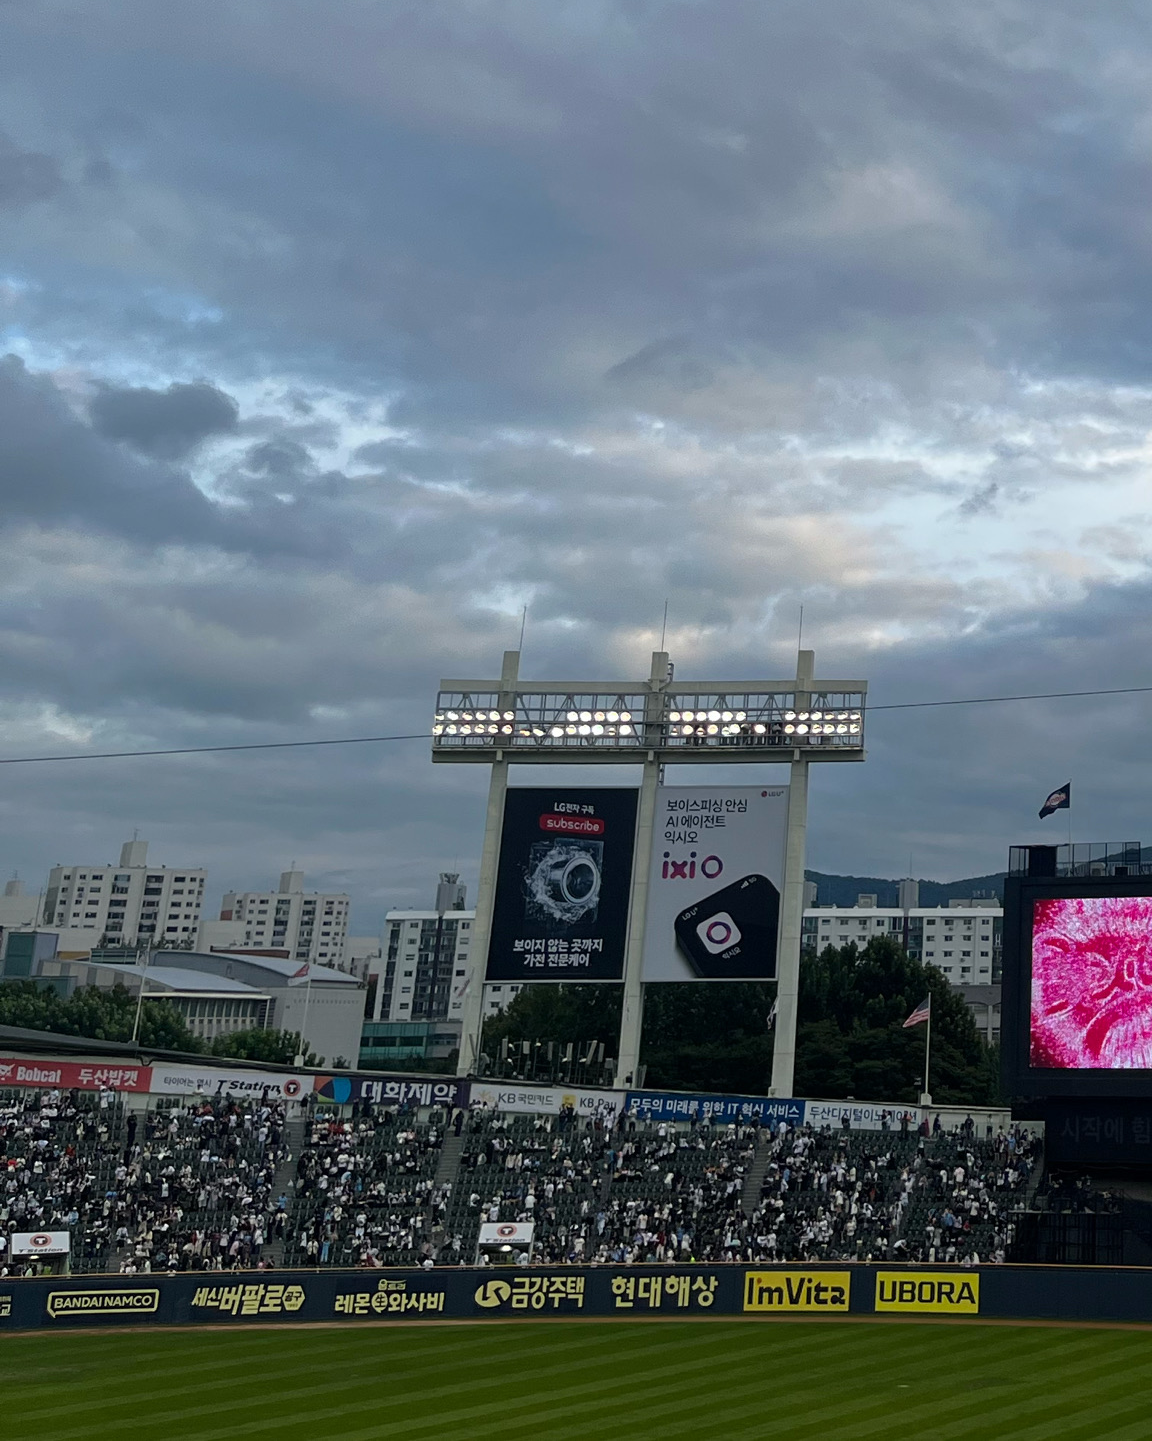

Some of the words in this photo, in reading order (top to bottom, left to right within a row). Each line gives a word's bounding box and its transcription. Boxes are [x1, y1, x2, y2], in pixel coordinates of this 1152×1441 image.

[666, 799, 722, 813] 보이스피싱
[725, 799, 748, 813] 안심
[547, 818, 600, 831] subscribe
[666, 816, 679, 828] AI
[681, 815, 726, 828] 에이전트
[664, 831, 698, 844] 익시오
[513, 939, 545, 952] 보이지
[547, 939, 569, 952] 않는
[571, 939, 603, 952] 곳까지
[524, 953, 545, 967] 가전
[547, 953, 590, 967] 전문케어
[17, 1067, 62, 1083] Bobcat
[78, 1069, 138, 1087] 두산밥캣
[361, 1081, 458, 1105] 대화제약
[498, 1093, 516, 1104] KB
[518, 1093, 553, 1106] 국민카드
[580, 1097, 594, 1108] KB
[728, 1103, 739, 1115] IT
[766, 1104, 799, 1118] 서비스
[1061, 1115, 1125, 1144] 시작에
[511, 1277, 585, 1309] 금강주택
[611, 1275, 718, 1308] 현대해상
[879, 1280, 976, 1304] UBORA
[54, 1296, 102, 1309] BANDAI
[104, 1295, 152, 1307] NAMCO
